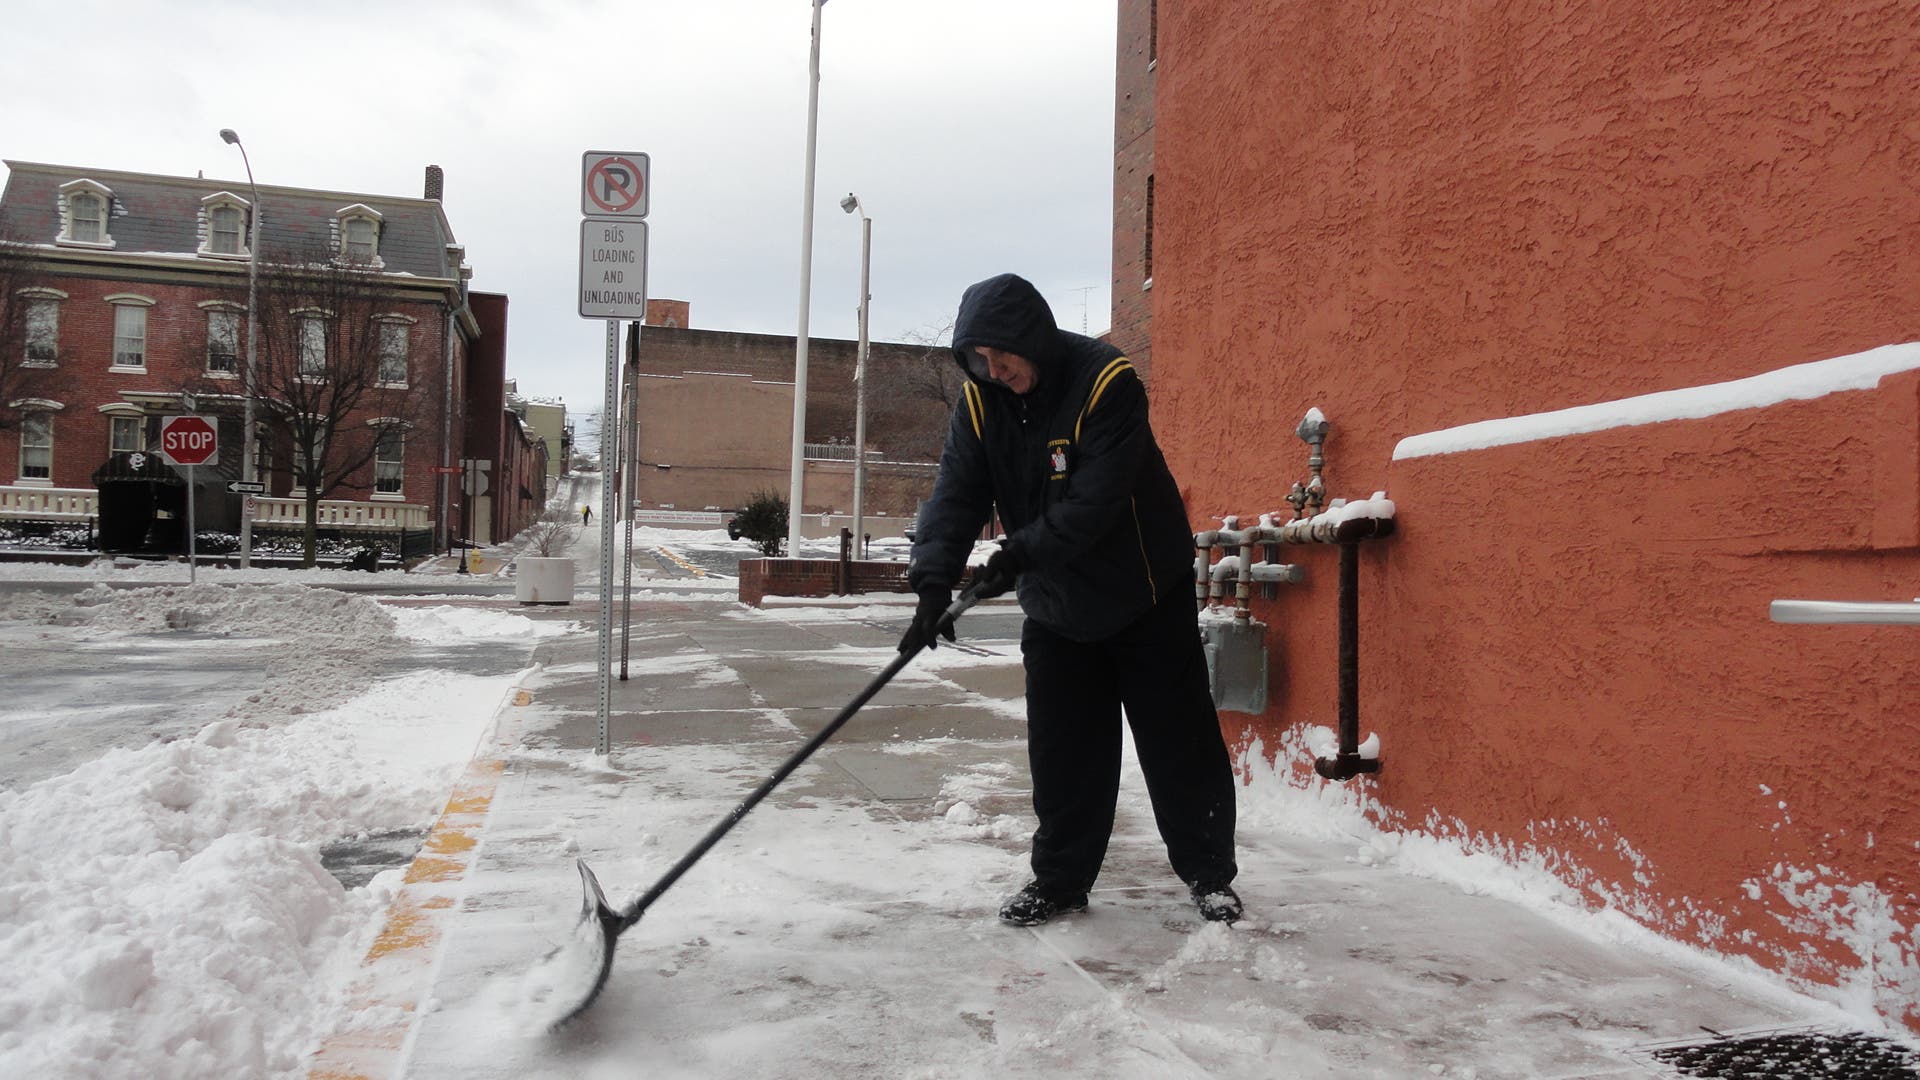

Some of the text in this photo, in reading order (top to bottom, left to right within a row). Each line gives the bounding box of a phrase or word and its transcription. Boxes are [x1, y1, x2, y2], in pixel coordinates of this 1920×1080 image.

[604, 229, 624, 243] BUS
[592, 248, 635, 263] LOADING
[603, 270, 624, 284] AND
[584, 290, 641, 305] UNLOADING
[166, 431, 213, 450] STOP
